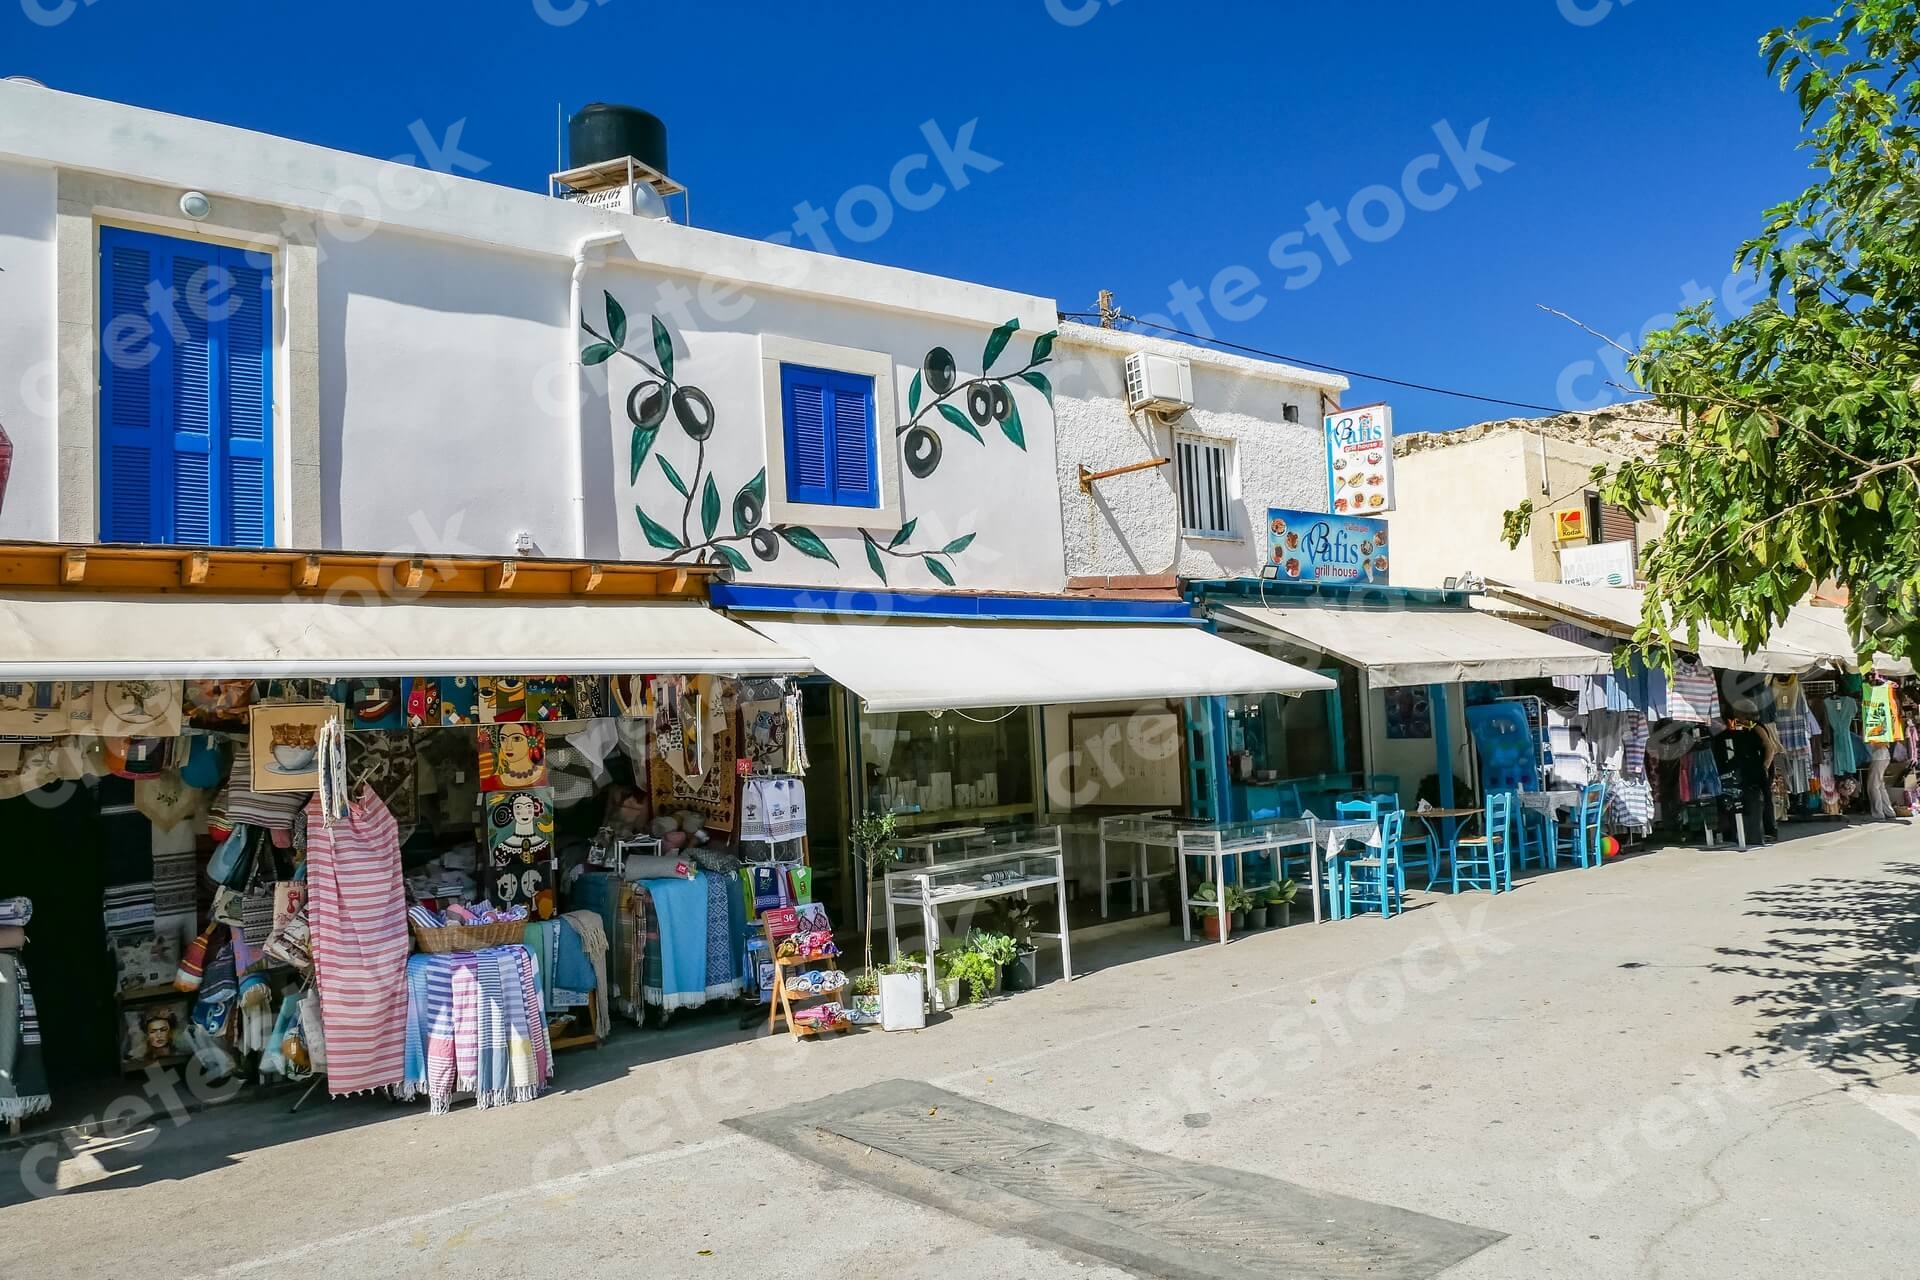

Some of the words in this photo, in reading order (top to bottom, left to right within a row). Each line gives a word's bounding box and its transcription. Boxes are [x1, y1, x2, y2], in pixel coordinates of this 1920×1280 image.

[1562, 529, 1582, 537] Kodak
[1314, 565, 1330, 578] grill
[1332, 565, 1358, 577] house
[783, 913, 795, 923] 3€
